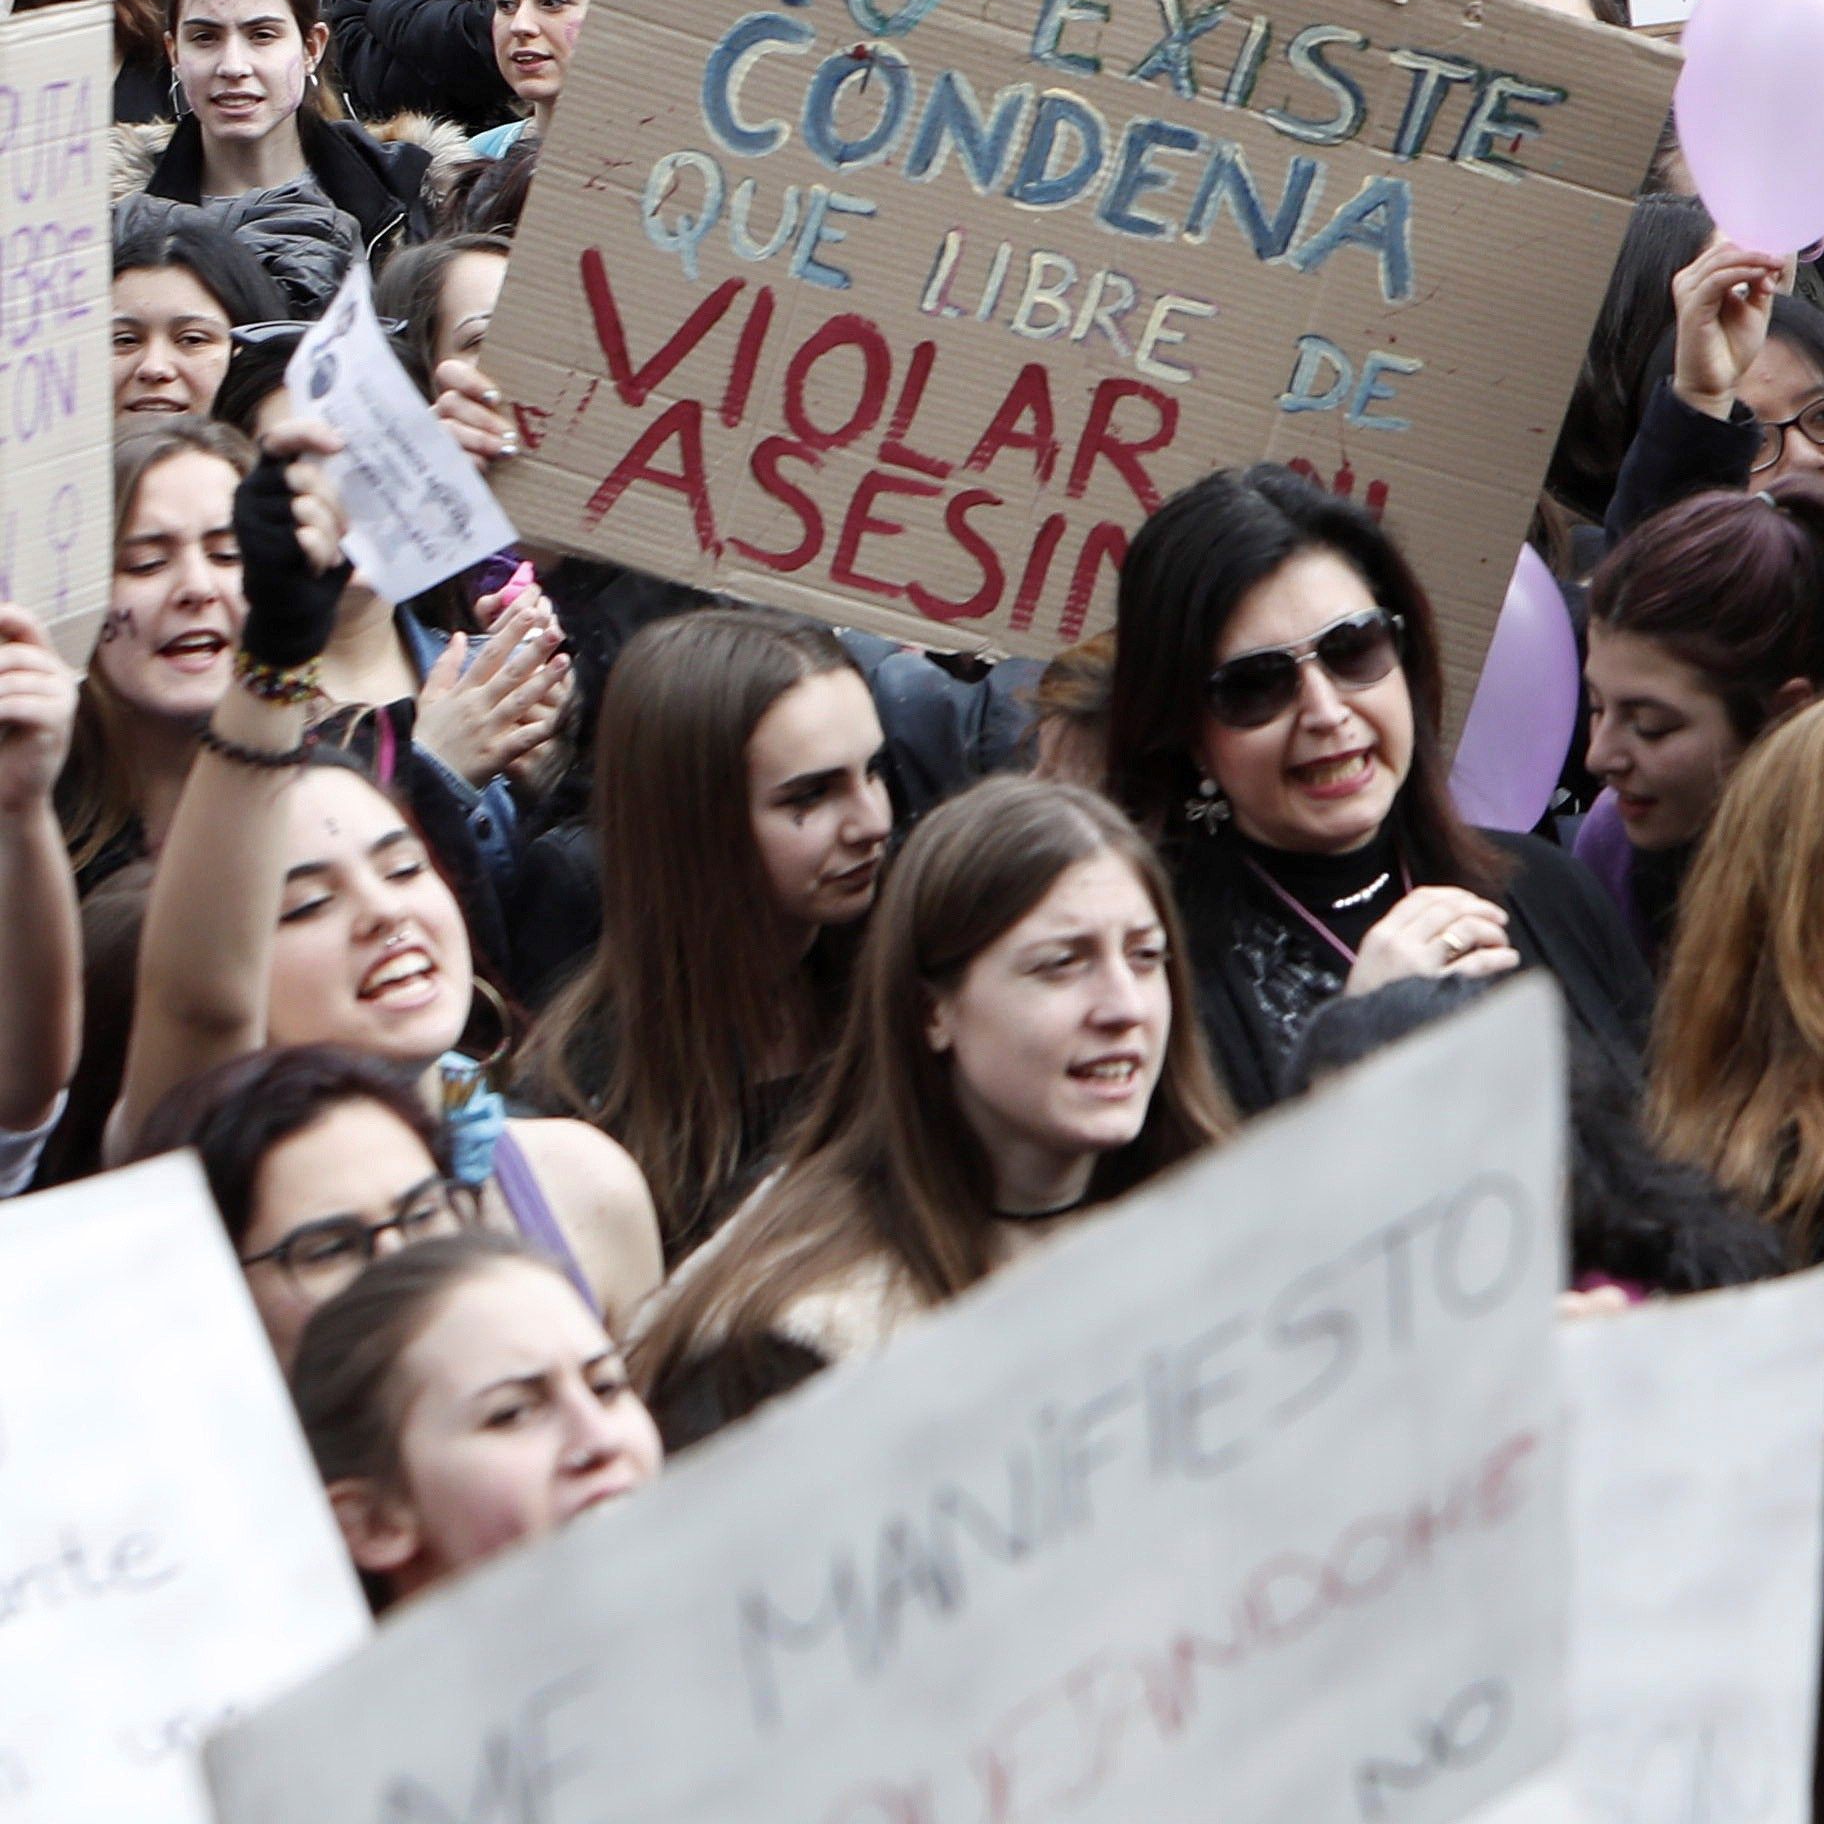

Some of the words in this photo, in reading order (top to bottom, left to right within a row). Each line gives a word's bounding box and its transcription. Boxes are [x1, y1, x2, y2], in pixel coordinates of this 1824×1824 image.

[639, 149, 880, 293] QUE
[918, 226, 1218, 385] LIBRE
[1279, 333, 1427, 434] DE
[699, 9, 1420, 306] CONDENA
[579, 246, 1182, 516] VIOLAR
[583, 399, 1130, 645] ASESIN
[737, 1166, 1533, 1735] MANIFIESTO
